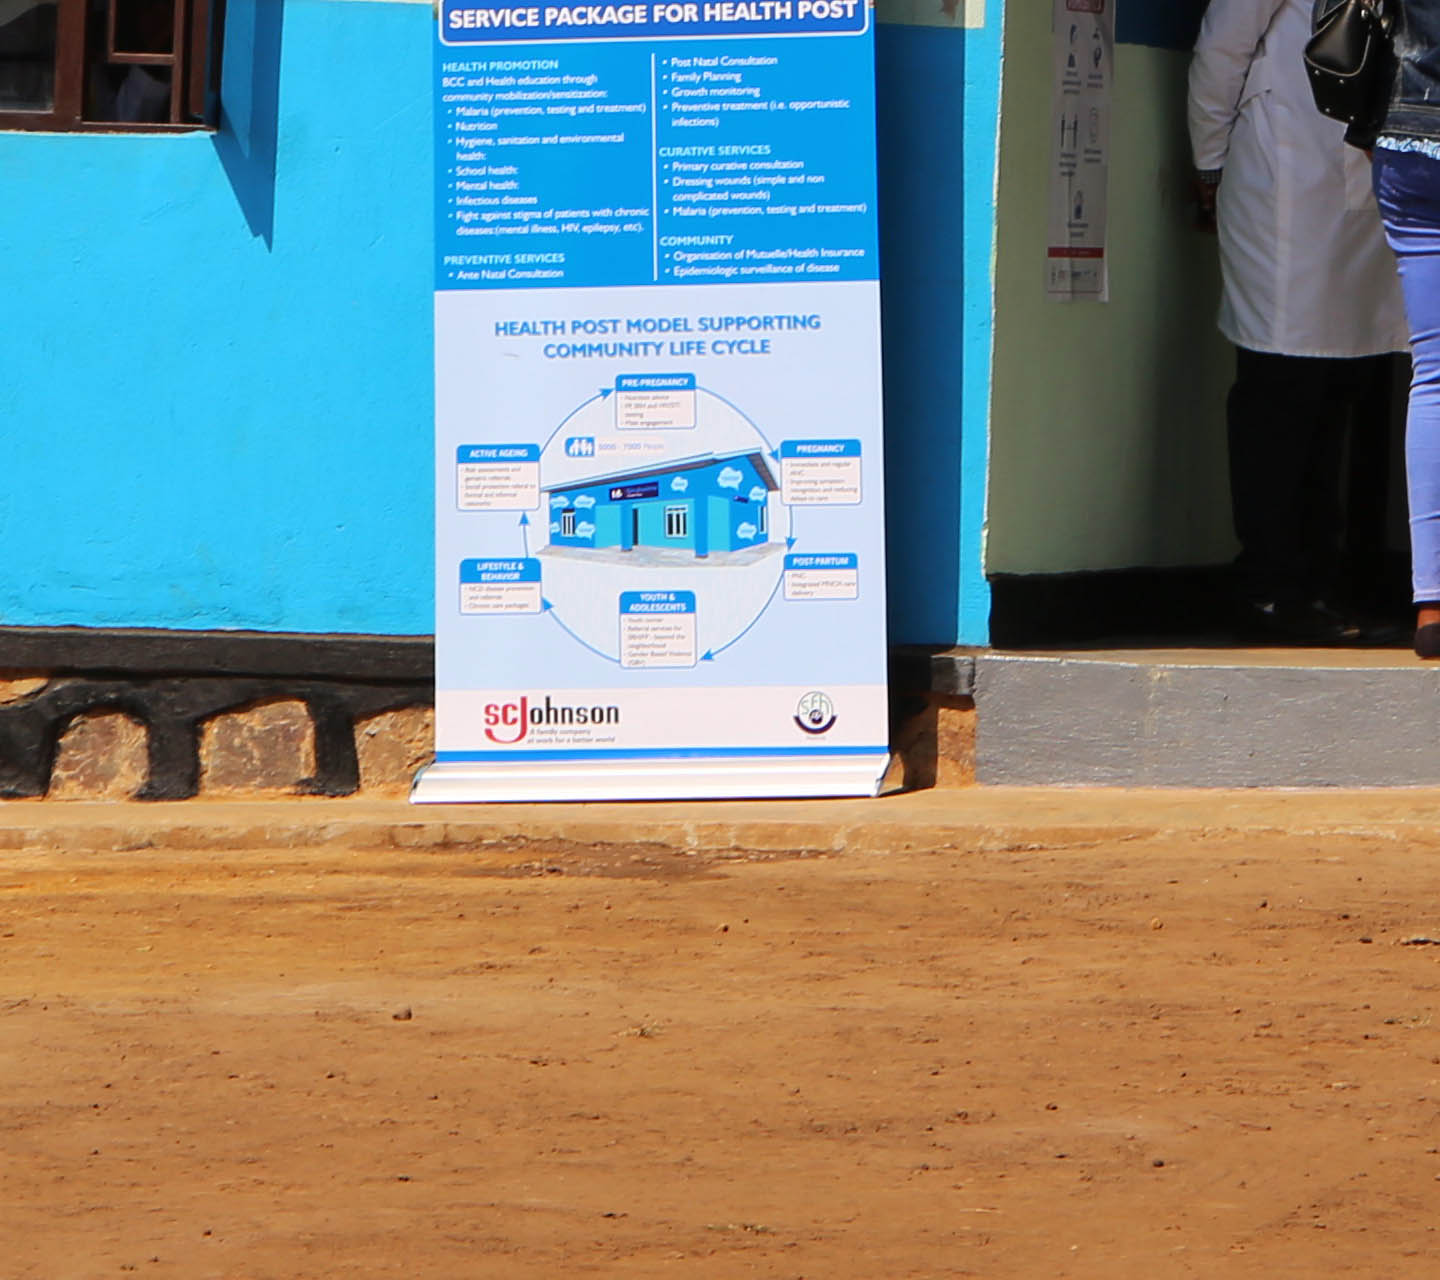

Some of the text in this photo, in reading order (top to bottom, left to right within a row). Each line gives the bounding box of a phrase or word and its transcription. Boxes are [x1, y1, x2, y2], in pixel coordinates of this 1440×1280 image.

[450, 0, 858, 28] SERVICE PACKAGE FOR HEALTH POST
[443, 60, 558, 72] HEALTH PROMOTION
[671, 56, 777, 67] Post Natal Consultation
[443, 74, 597, 87] BCC and Health education through
[672, 72, 741, 84] Family Planning
[456, 122, 497, 131] Nutrition
[659, 145, 771, 157] CURATIVE SERVICES
[660, 235, 733, 246] COMMUNITY
[444, 253, 565, 265] PREVENTIVE SERVICES
[495, 315, 820, 336] HEALTH POST MODEL SUPPORTING
[544, 339, 770, 358] COMMUNITY LIFE CYCLE
[469, 448, 498, 458] ACTIVE
